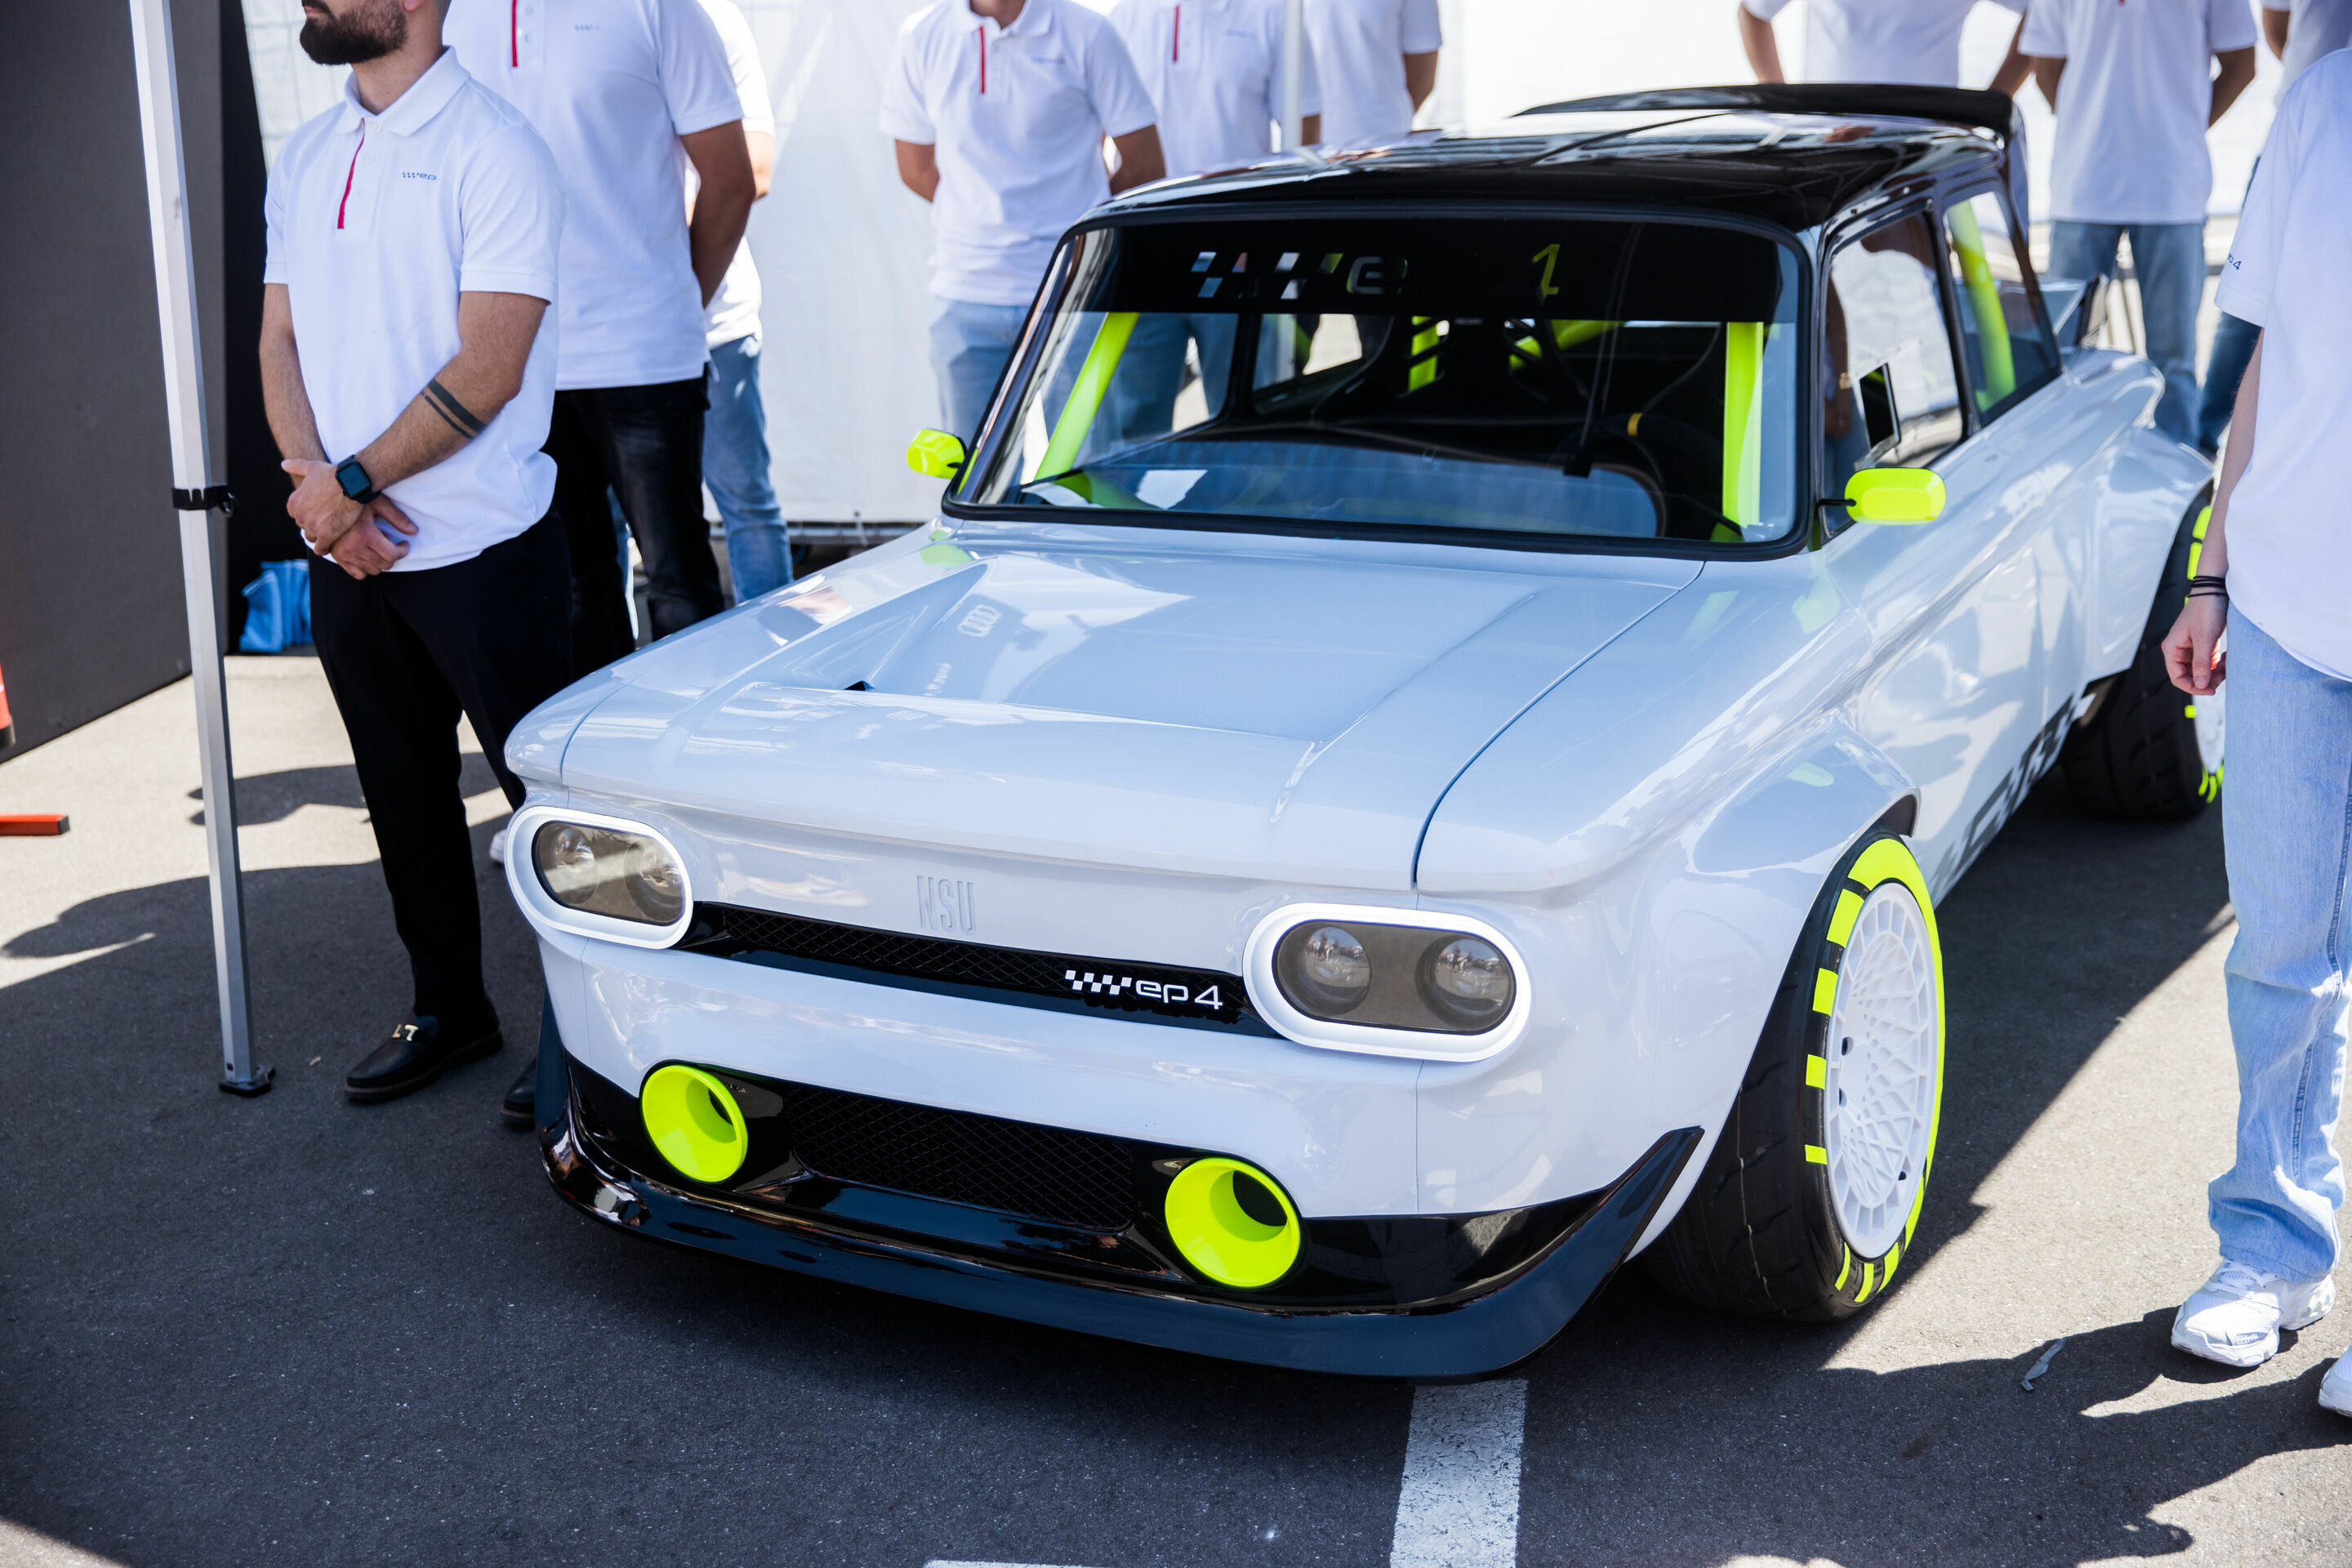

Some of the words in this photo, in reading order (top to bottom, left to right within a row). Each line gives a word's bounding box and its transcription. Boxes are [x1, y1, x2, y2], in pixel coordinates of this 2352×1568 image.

[916, 875, 977, 935] NSU
[1135, 979, 1188, 1004] ep
[1194, 985, 1223, 1010] 4
